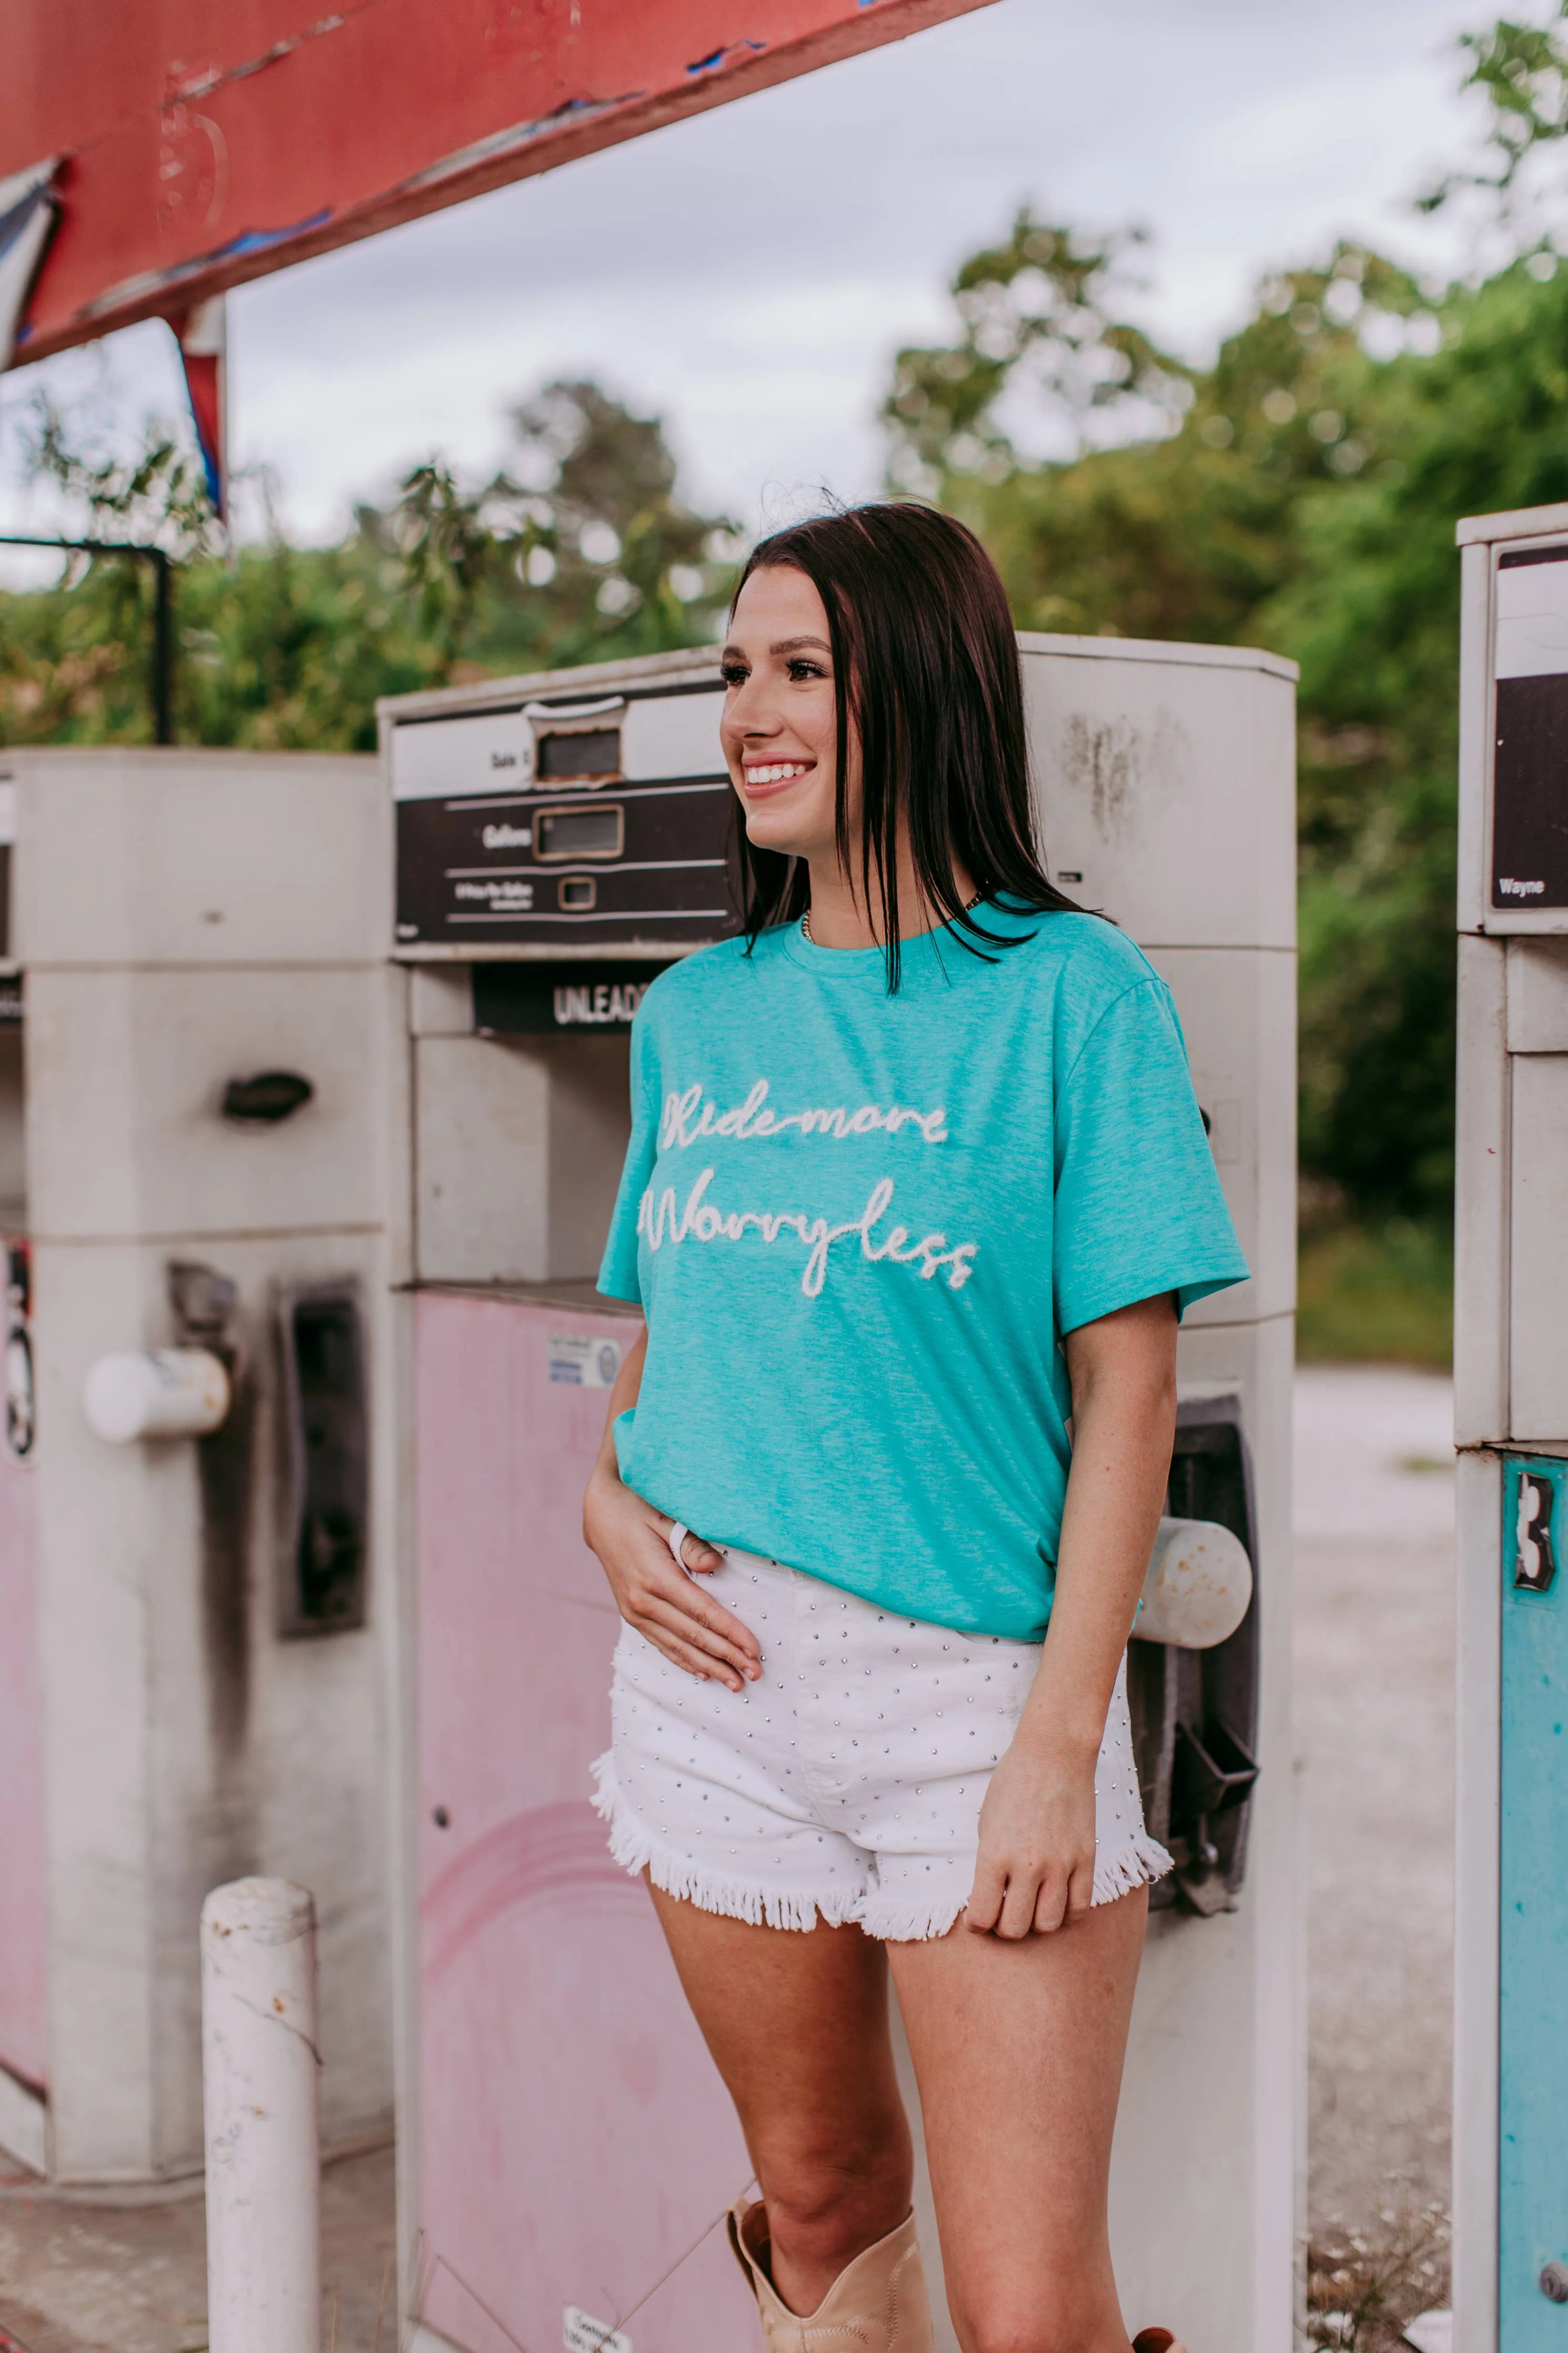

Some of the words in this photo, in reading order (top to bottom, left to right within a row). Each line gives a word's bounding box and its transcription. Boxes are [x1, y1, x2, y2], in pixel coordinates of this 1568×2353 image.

[1499, 878, 1545, 898] Wayne
[554, 984, 649, 1024] UNLEAD
[663, 1079, 789, 1150] Ride
[800, 1105, 948, 1143] more
[636, 1168, 835, 1298] Worry
[858, 1179, 978, 1290] less
